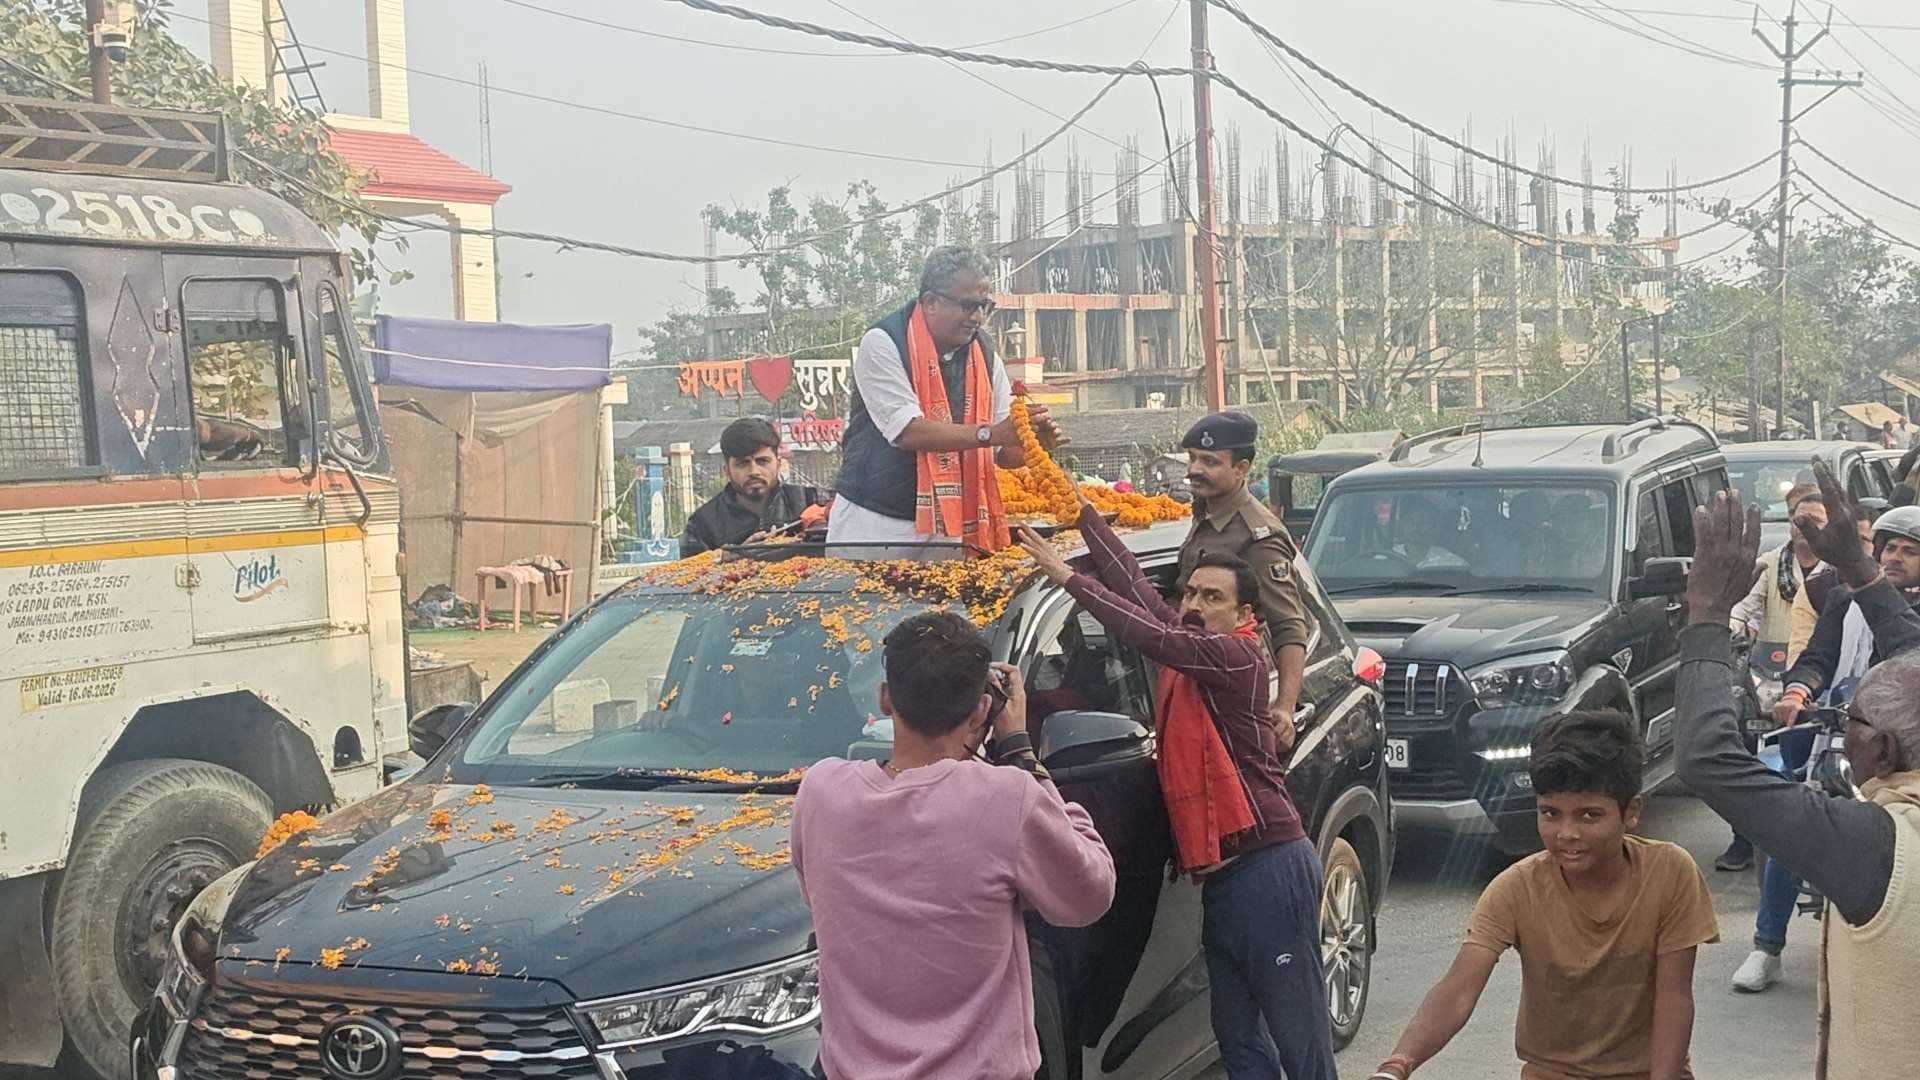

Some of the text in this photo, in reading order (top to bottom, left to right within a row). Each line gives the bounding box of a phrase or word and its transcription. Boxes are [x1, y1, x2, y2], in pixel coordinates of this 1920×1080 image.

[676, 360, 745, 399] अप्पन
[16, 597, 50, 612] LADDU
[53, 594, 83, 609] GOPAL
[87, 592, 109, 606] KSK
[20, 675, 49, 693] PERMIT
[69, 683, 117, 702] 16.06.2026
